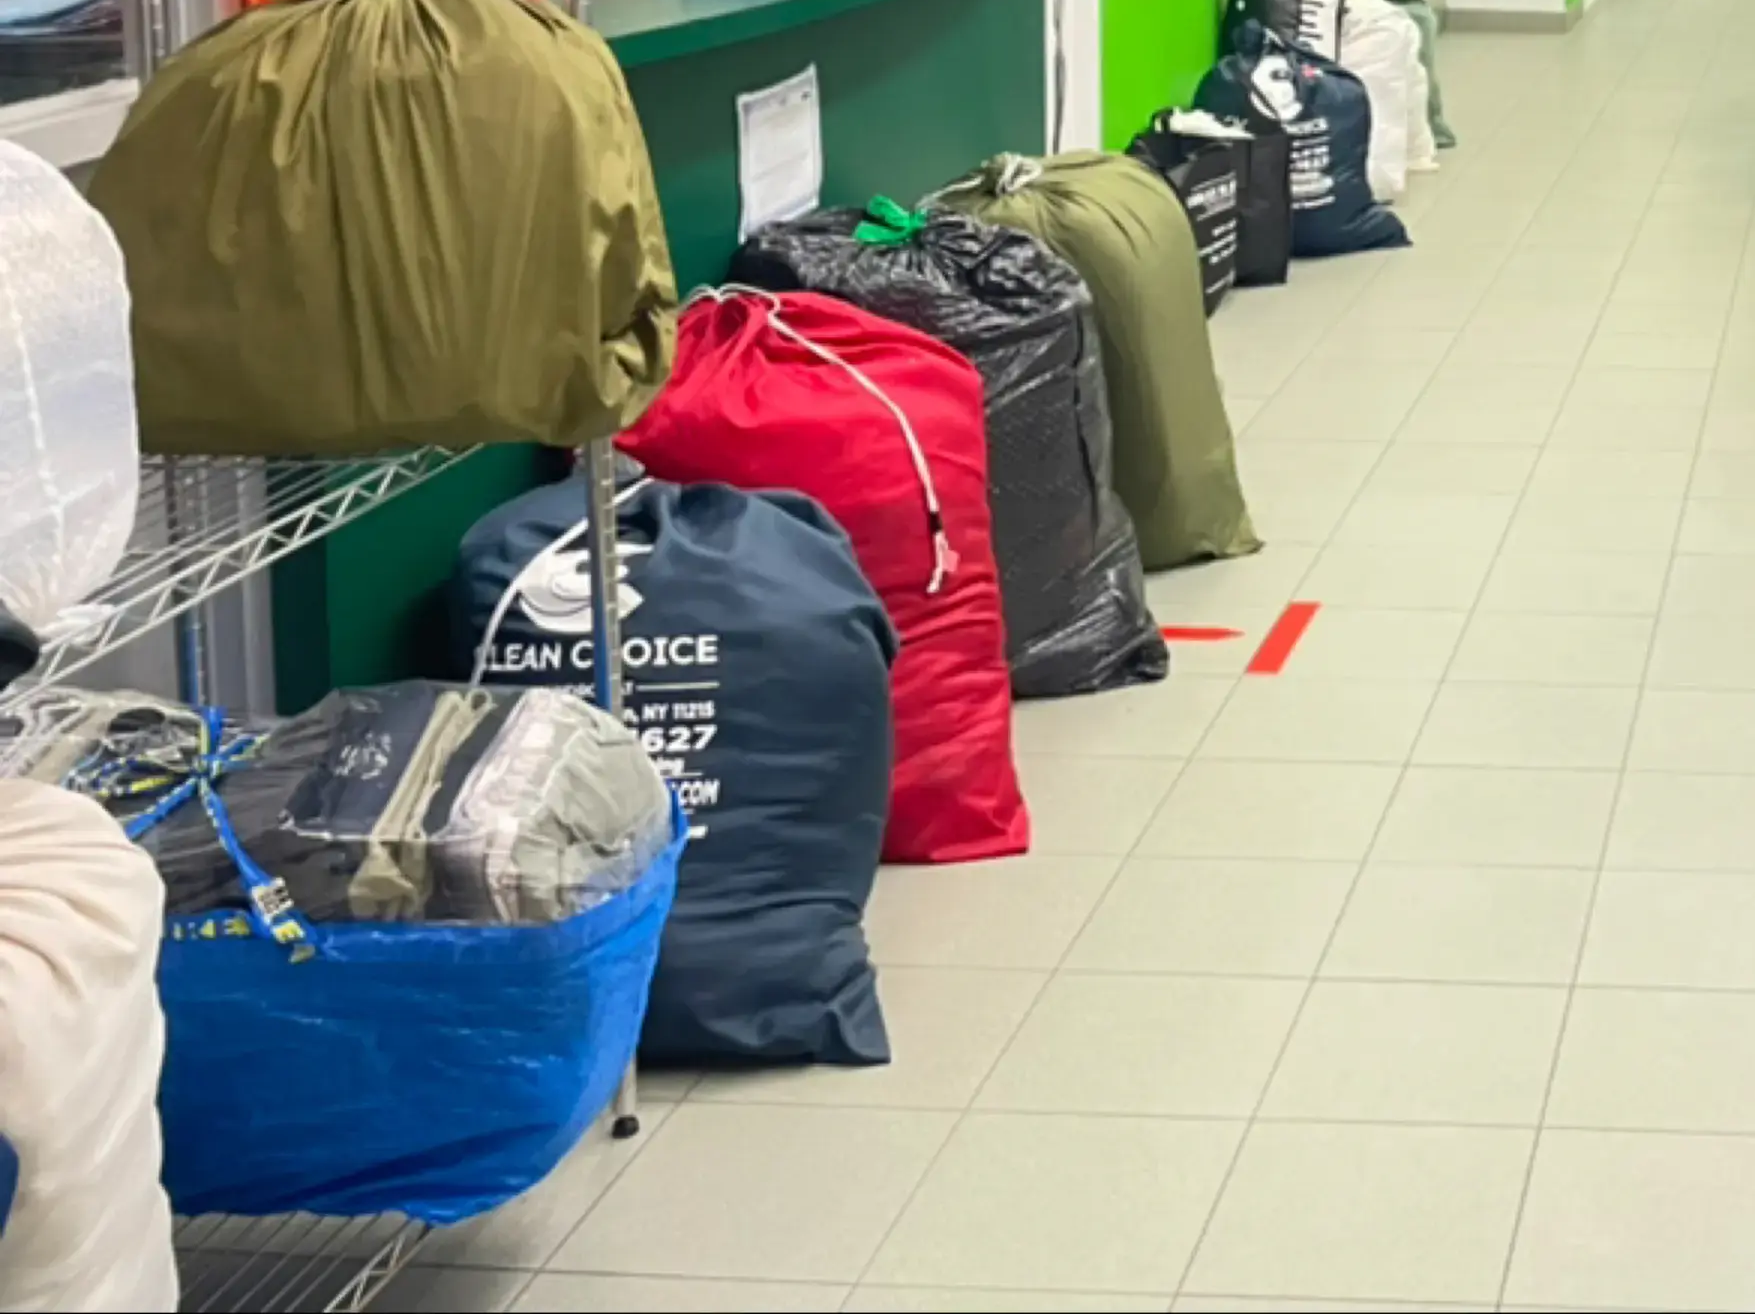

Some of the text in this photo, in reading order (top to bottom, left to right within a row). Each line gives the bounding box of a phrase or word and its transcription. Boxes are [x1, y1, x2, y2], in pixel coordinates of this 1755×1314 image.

[570, 634, 719, 670] COICE
[641, 702, 669, 721] NY
[630, 724, 718, 753] 627
